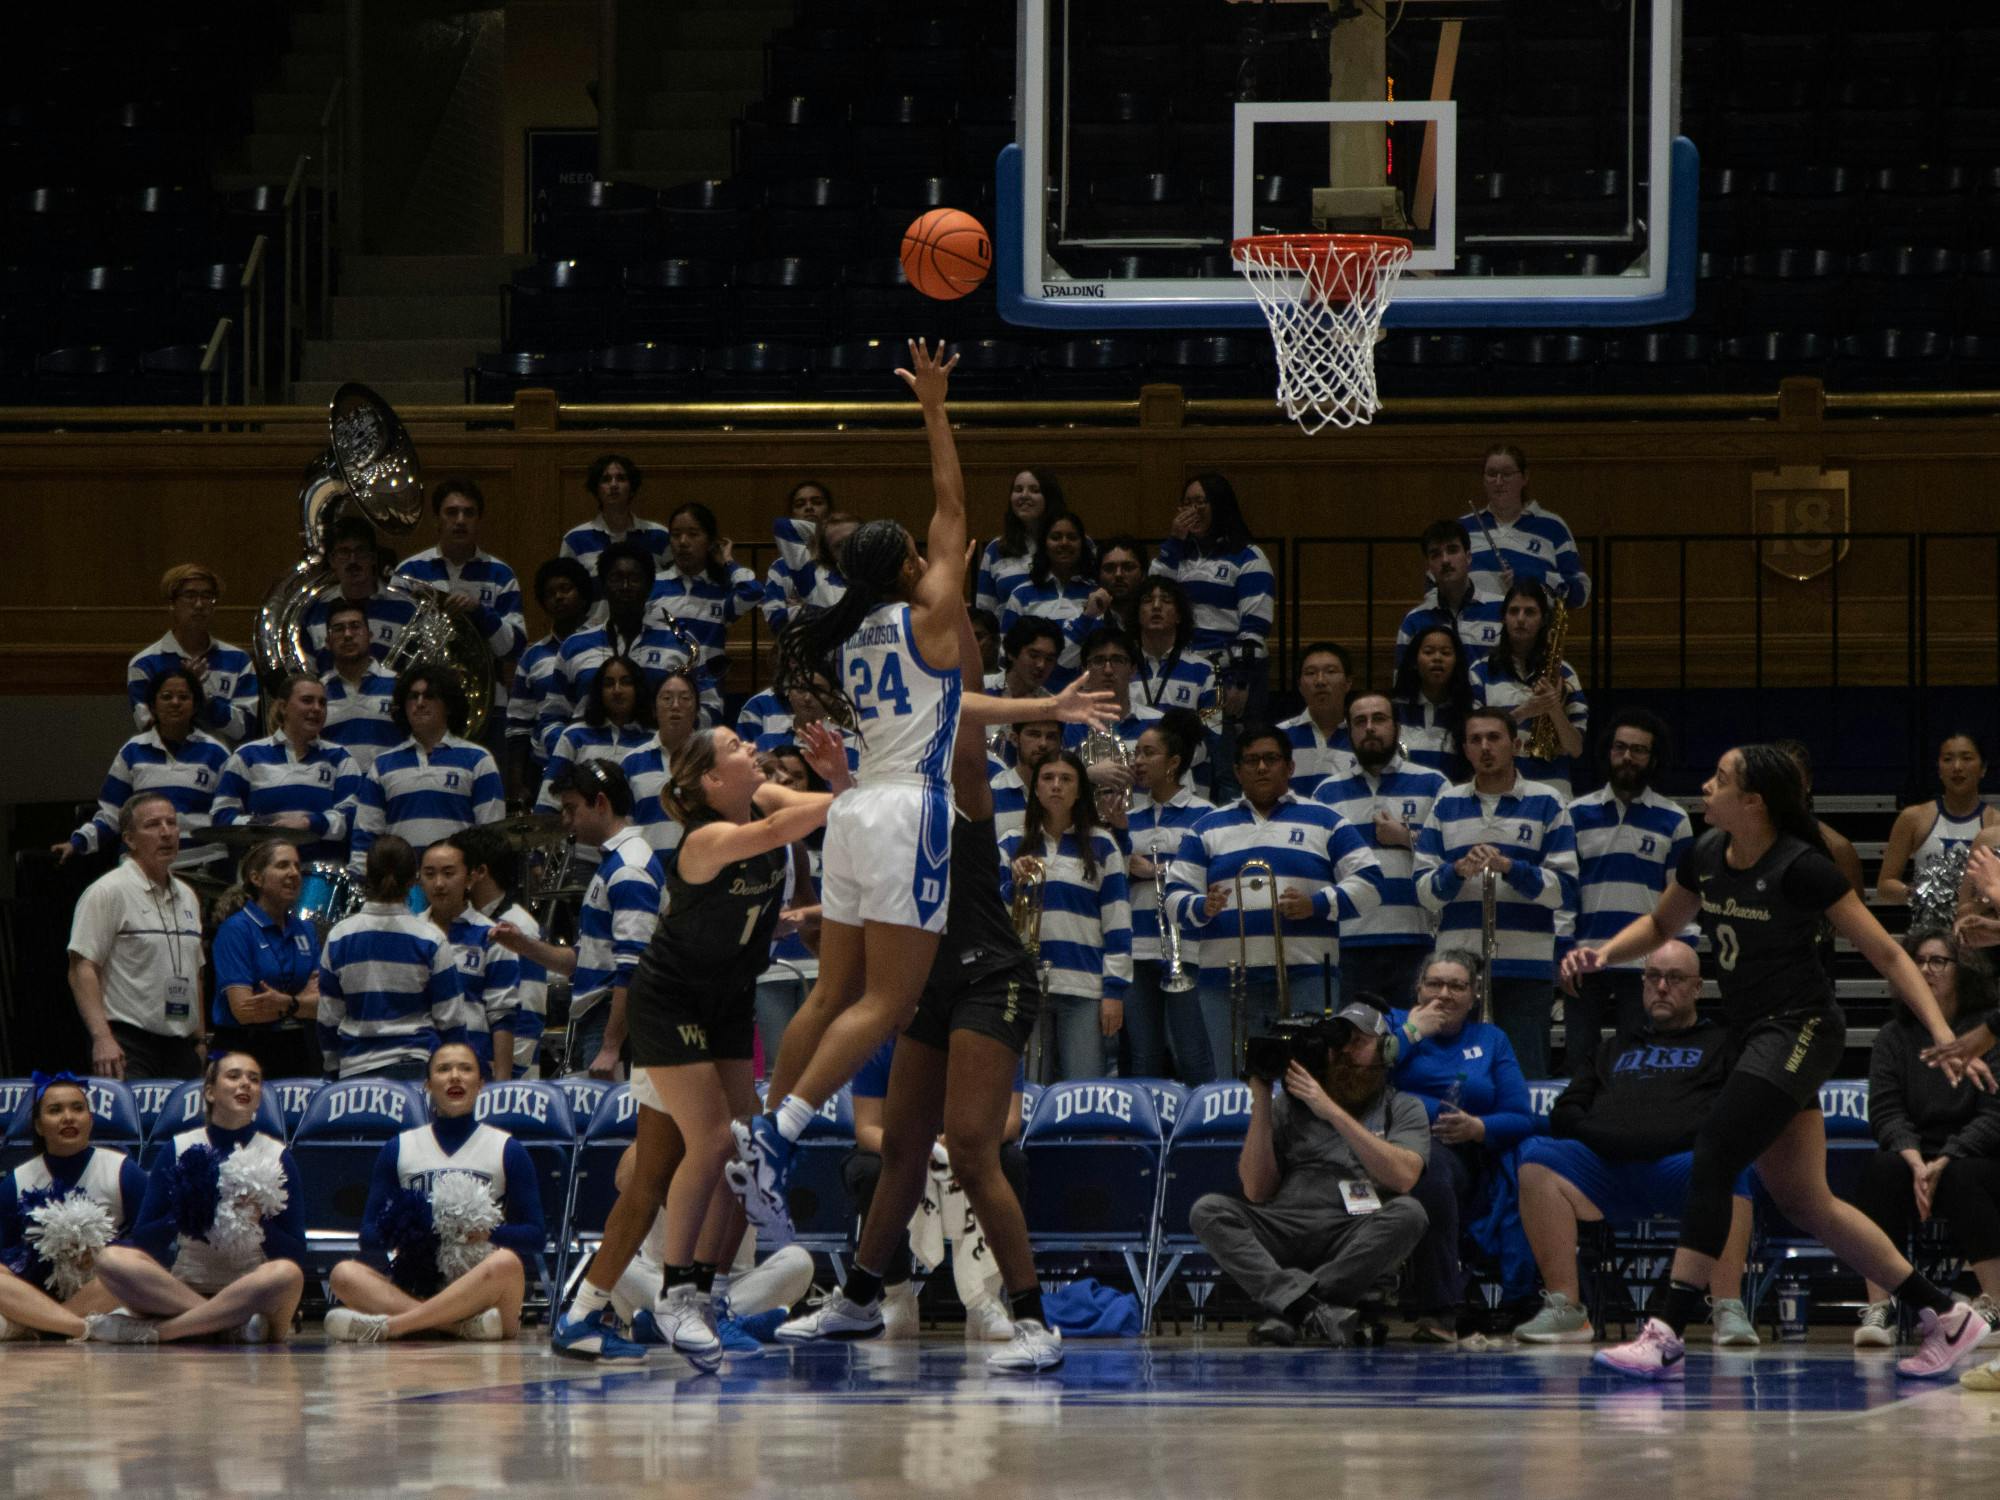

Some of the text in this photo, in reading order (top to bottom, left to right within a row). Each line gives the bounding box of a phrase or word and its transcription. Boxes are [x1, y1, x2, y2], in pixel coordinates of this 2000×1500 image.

[1042, 284, 1104, 298] SPALDING
[1763, 495, 1831, 556] 18
[850, 652, 912, 720] 24
[1716, 923, 1740, 971] 0
[1784, 1044, 1808, 1073] WAKE
[87, 1085, 116, 1121] KE
[328, 1086, 406, 1123] DUKE
[474, 1087, 549, 1124] DUKE
[1055, 1086, 1133, 1124] DUKE
[1203, 1087, 1254, 1125] DU
